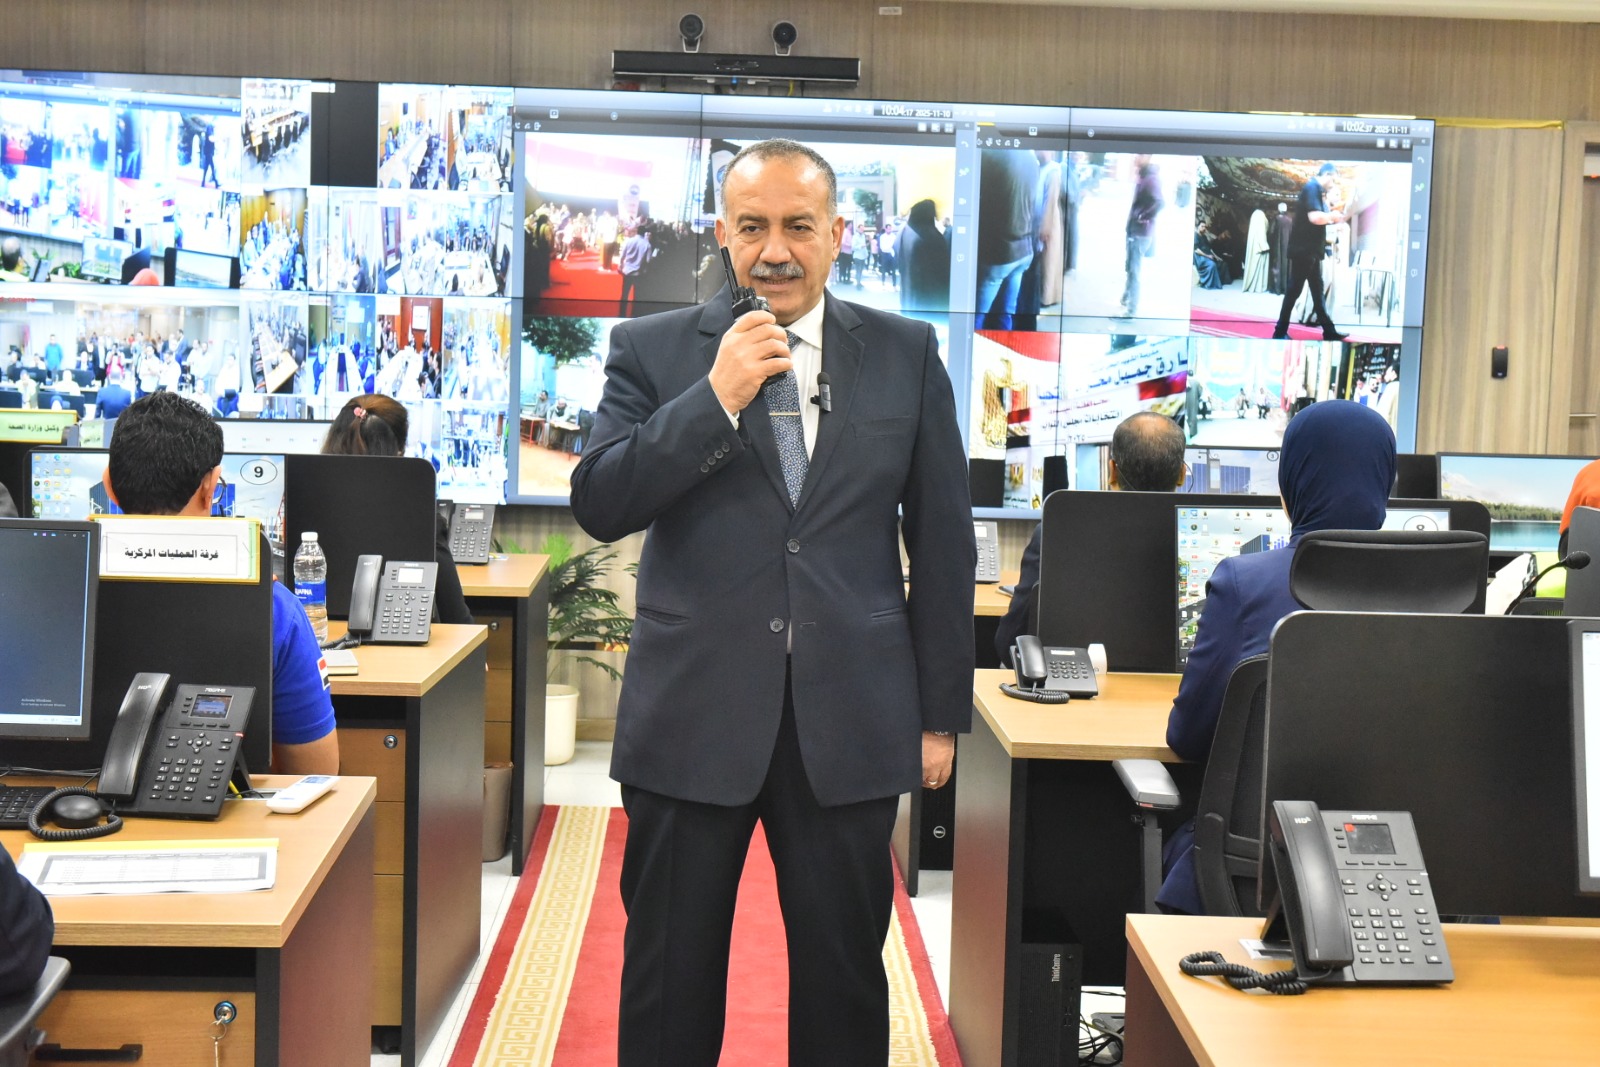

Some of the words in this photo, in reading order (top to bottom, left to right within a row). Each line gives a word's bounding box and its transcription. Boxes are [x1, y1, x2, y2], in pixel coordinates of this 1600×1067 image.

[254, 465, 264, 479] 9
[124, 547, 156, 559] المركزية
[158, 548, 198, 560] العمليات
[199, 549, 219, 560] غرفة
